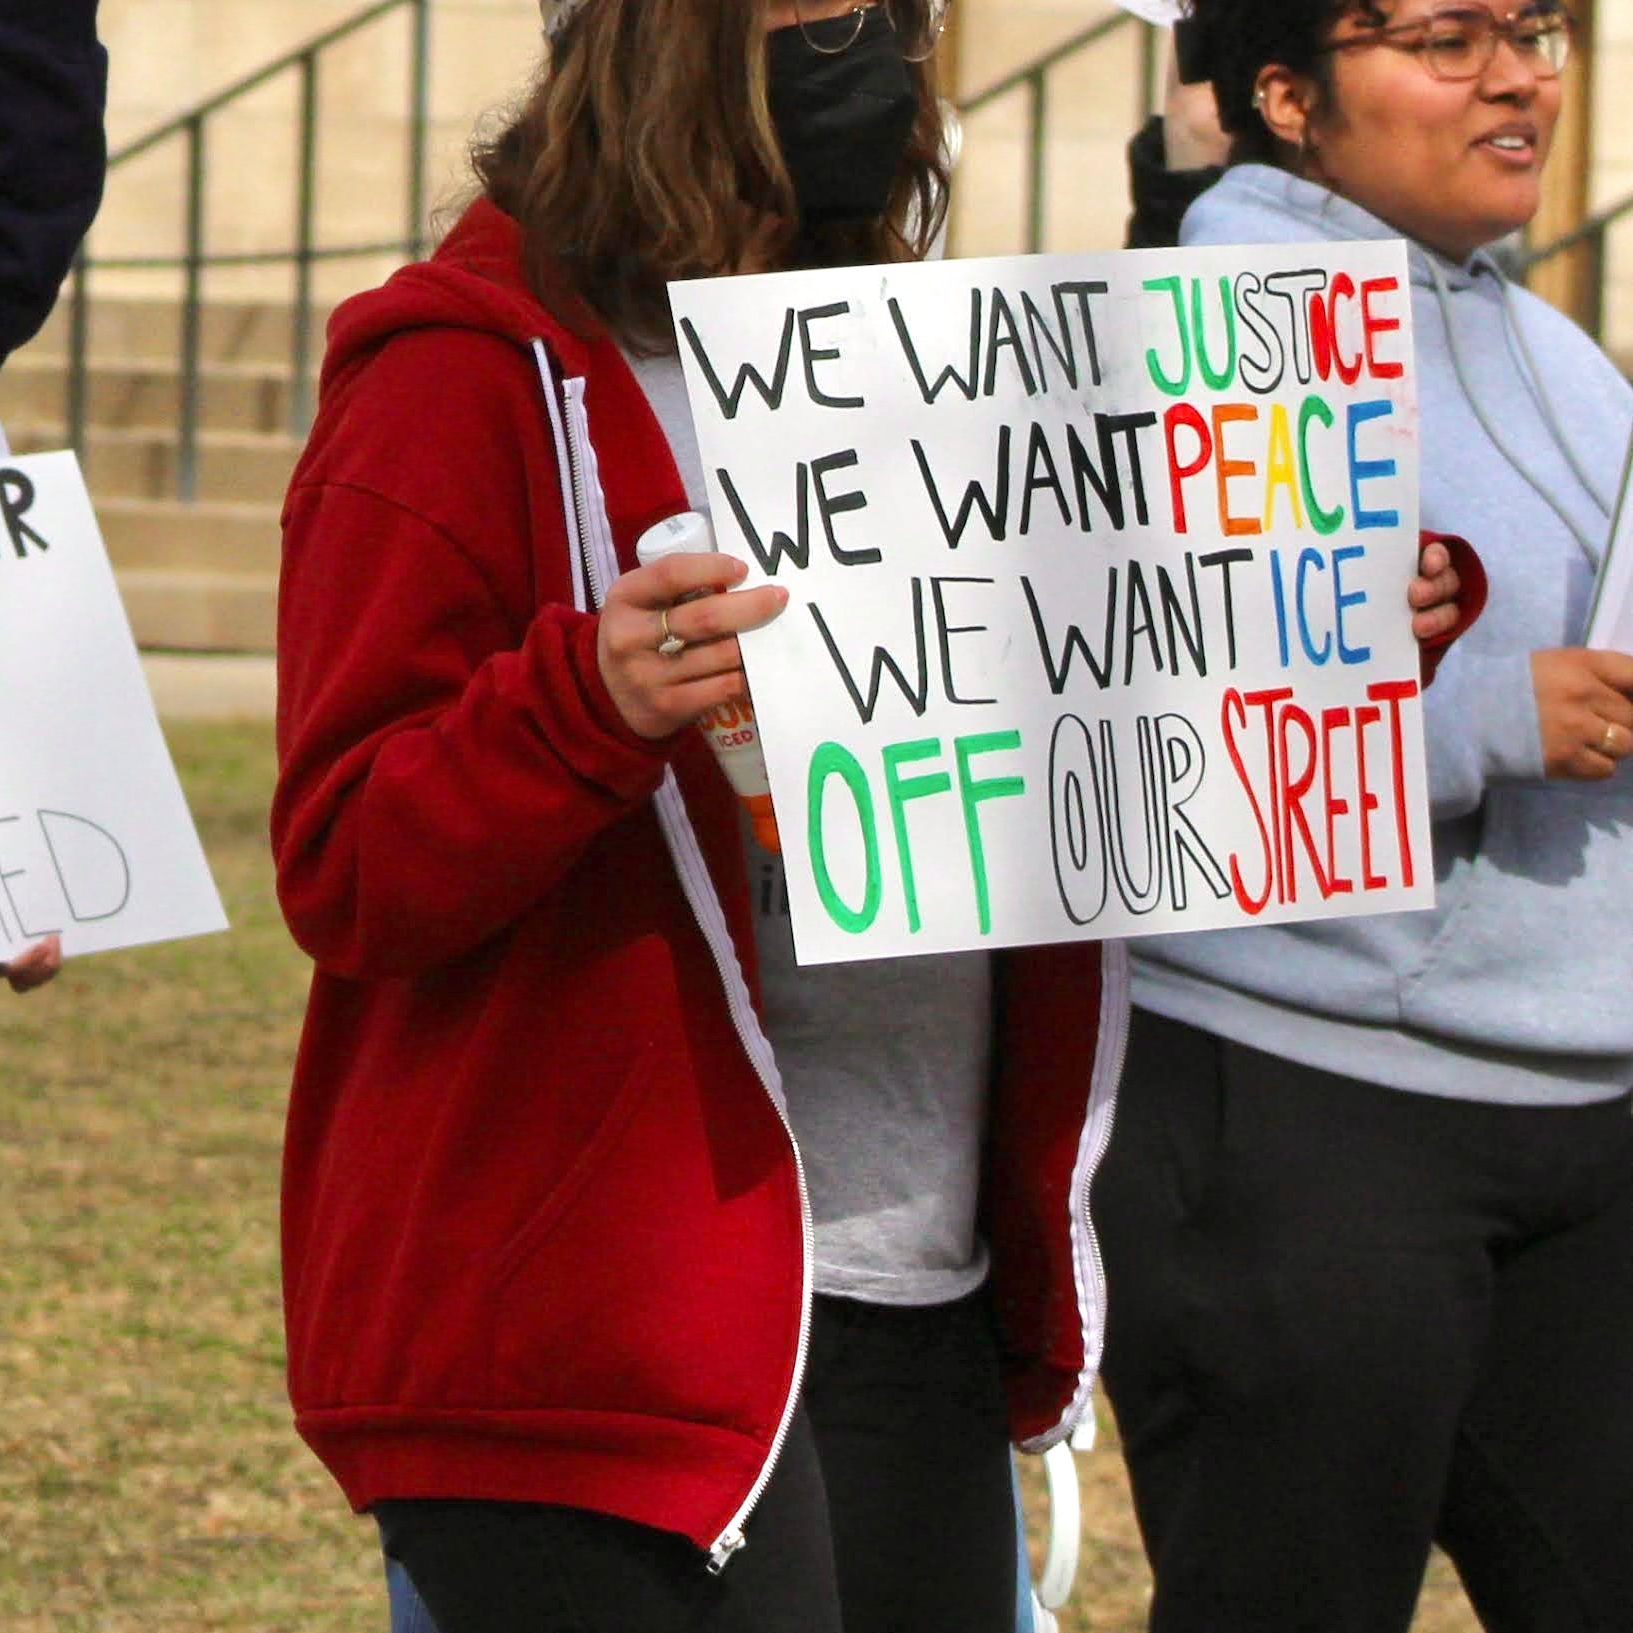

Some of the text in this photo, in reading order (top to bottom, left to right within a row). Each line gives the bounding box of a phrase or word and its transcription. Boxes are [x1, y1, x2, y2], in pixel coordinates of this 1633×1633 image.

[679, 267, 1404, 420] WE WANT JUSTICE
[716, 393, 1400, 577] WE WANT PEACE
[808, 545, 1371, 725] WE WANT ICE
[716, 729, 754, 749] ICED
[806, 679, 1418, 936] OFF OUR STREET
